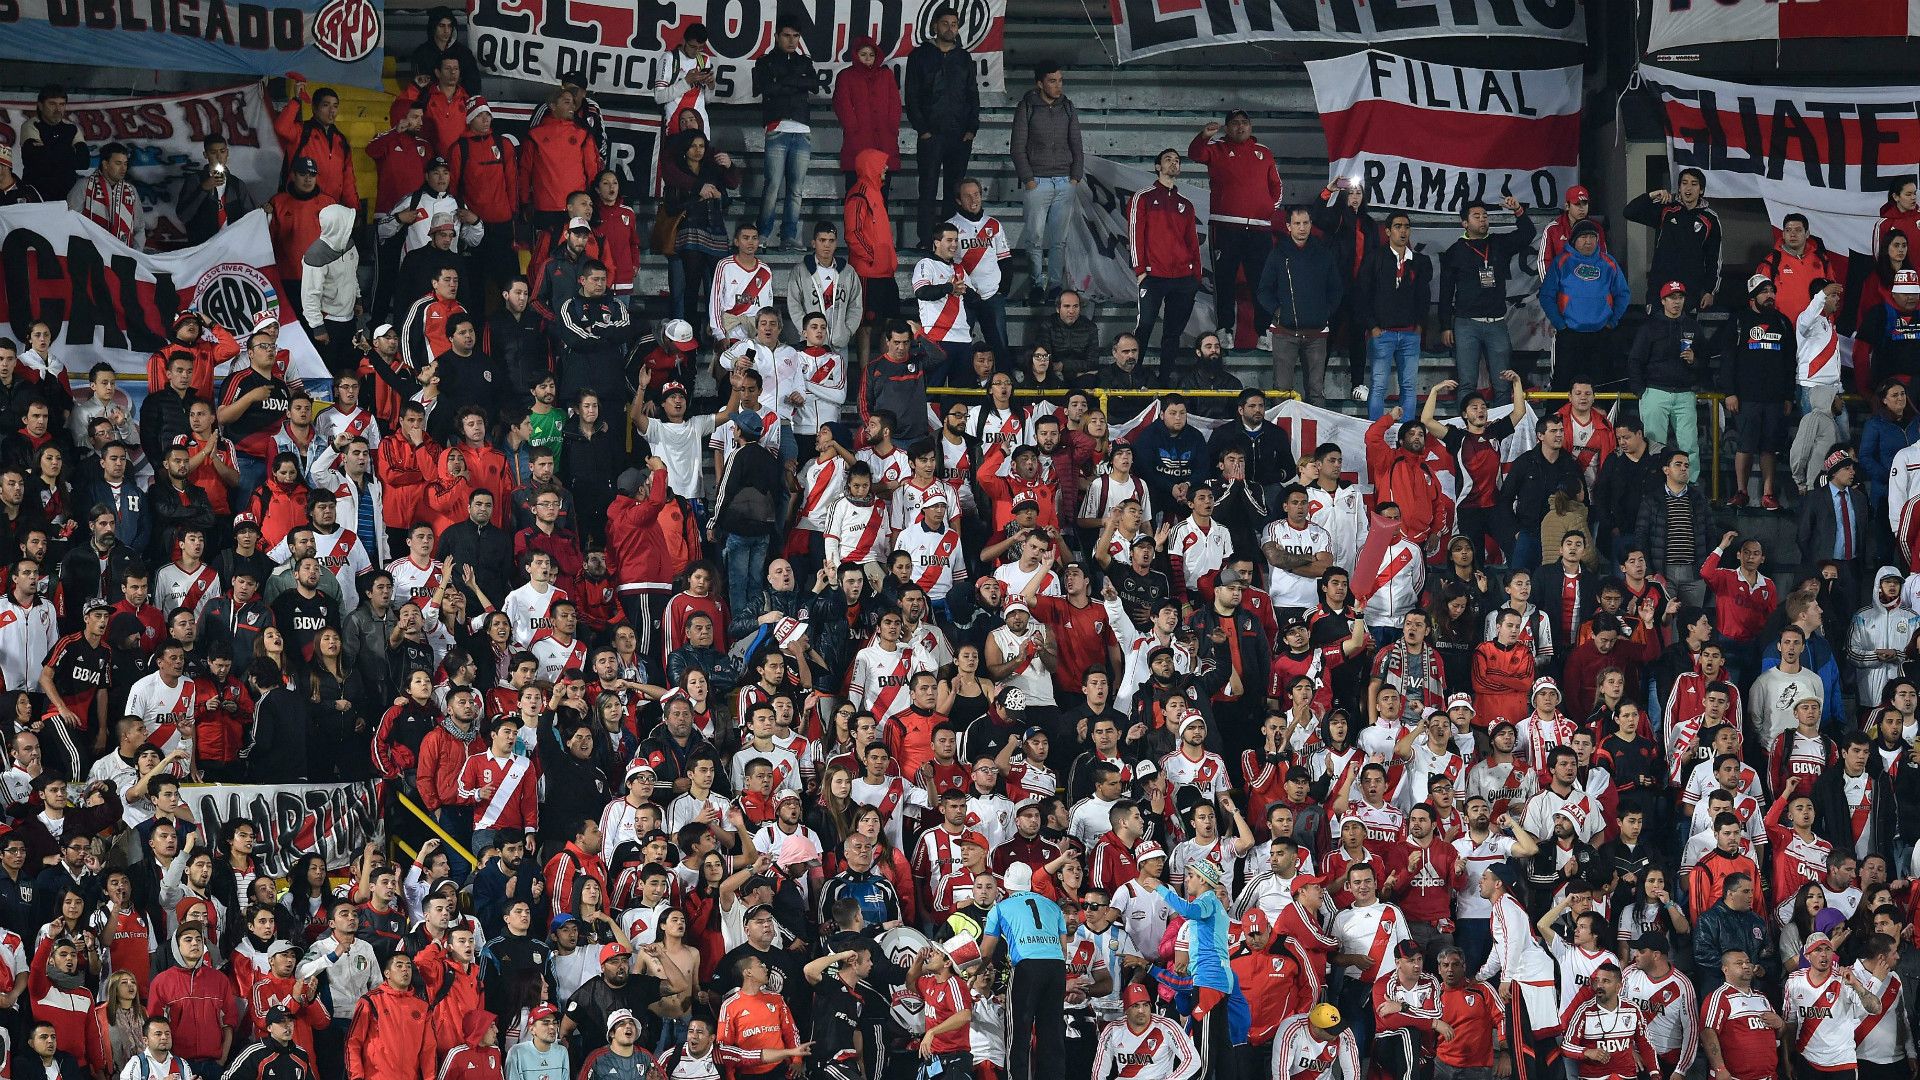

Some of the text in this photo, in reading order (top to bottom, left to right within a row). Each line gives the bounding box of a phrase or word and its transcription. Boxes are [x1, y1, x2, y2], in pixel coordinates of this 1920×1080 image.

[48, 0, 304, 51] OBLIGADO
[477, 33, 544, 76] QUE
[556, 45, 658, 91] DIFICI
[1368, 52, 1537, 116] FILIAL
[180, 90, 260, 149] DE
[1647, 79, 1920, 193] GUATE
[960, 237, 993, 250] BBVA
[221, 264, 243, 272] RIVER
[244, 267, 268, 287] PLATE
[262, 398, 289, 411] BBVA
[985, 432, 1017, 444] BBVA
[943, 467, 971, 479] BBVA
[1156, 465, 1191, 476] adidas
[1891, 467, 1898, 477] 9
[127, 495, 139, 512] H
[849, 523, 866, 533] BBVA
[316, 556, 350, 568] BBVA
[920, 555, 950, 568] BBVA
[410, 587, 436, 598] BBV
[293, 616, 327, 630] BBVA
[530, 617, 553, 630] BBV
[72, 666, 101, 685] BBVA
[878, 675, 911, 689] BBVA
[484, 769, 493, 782] 9
[1793, 763, 1821, 775] BBVA
[1366, 830, 1396, 843] BBVA
[1797, 861, 1819, 881] BBVA
[1410, 877, 1445, 888] adidas
[1025, 898, 1042, 930] 1
[1632, 996, 1665, 1016] BBVA
[1800, 1005, 1833, 1019] BBVA
[743, 1027, 761, 1038] BBVA
[1597, 1038, 1631, 1053] BBVA
[1118, 1053, 1154, 1066] BBVA
[1300, 1056, 1331, 1072] BBVA
